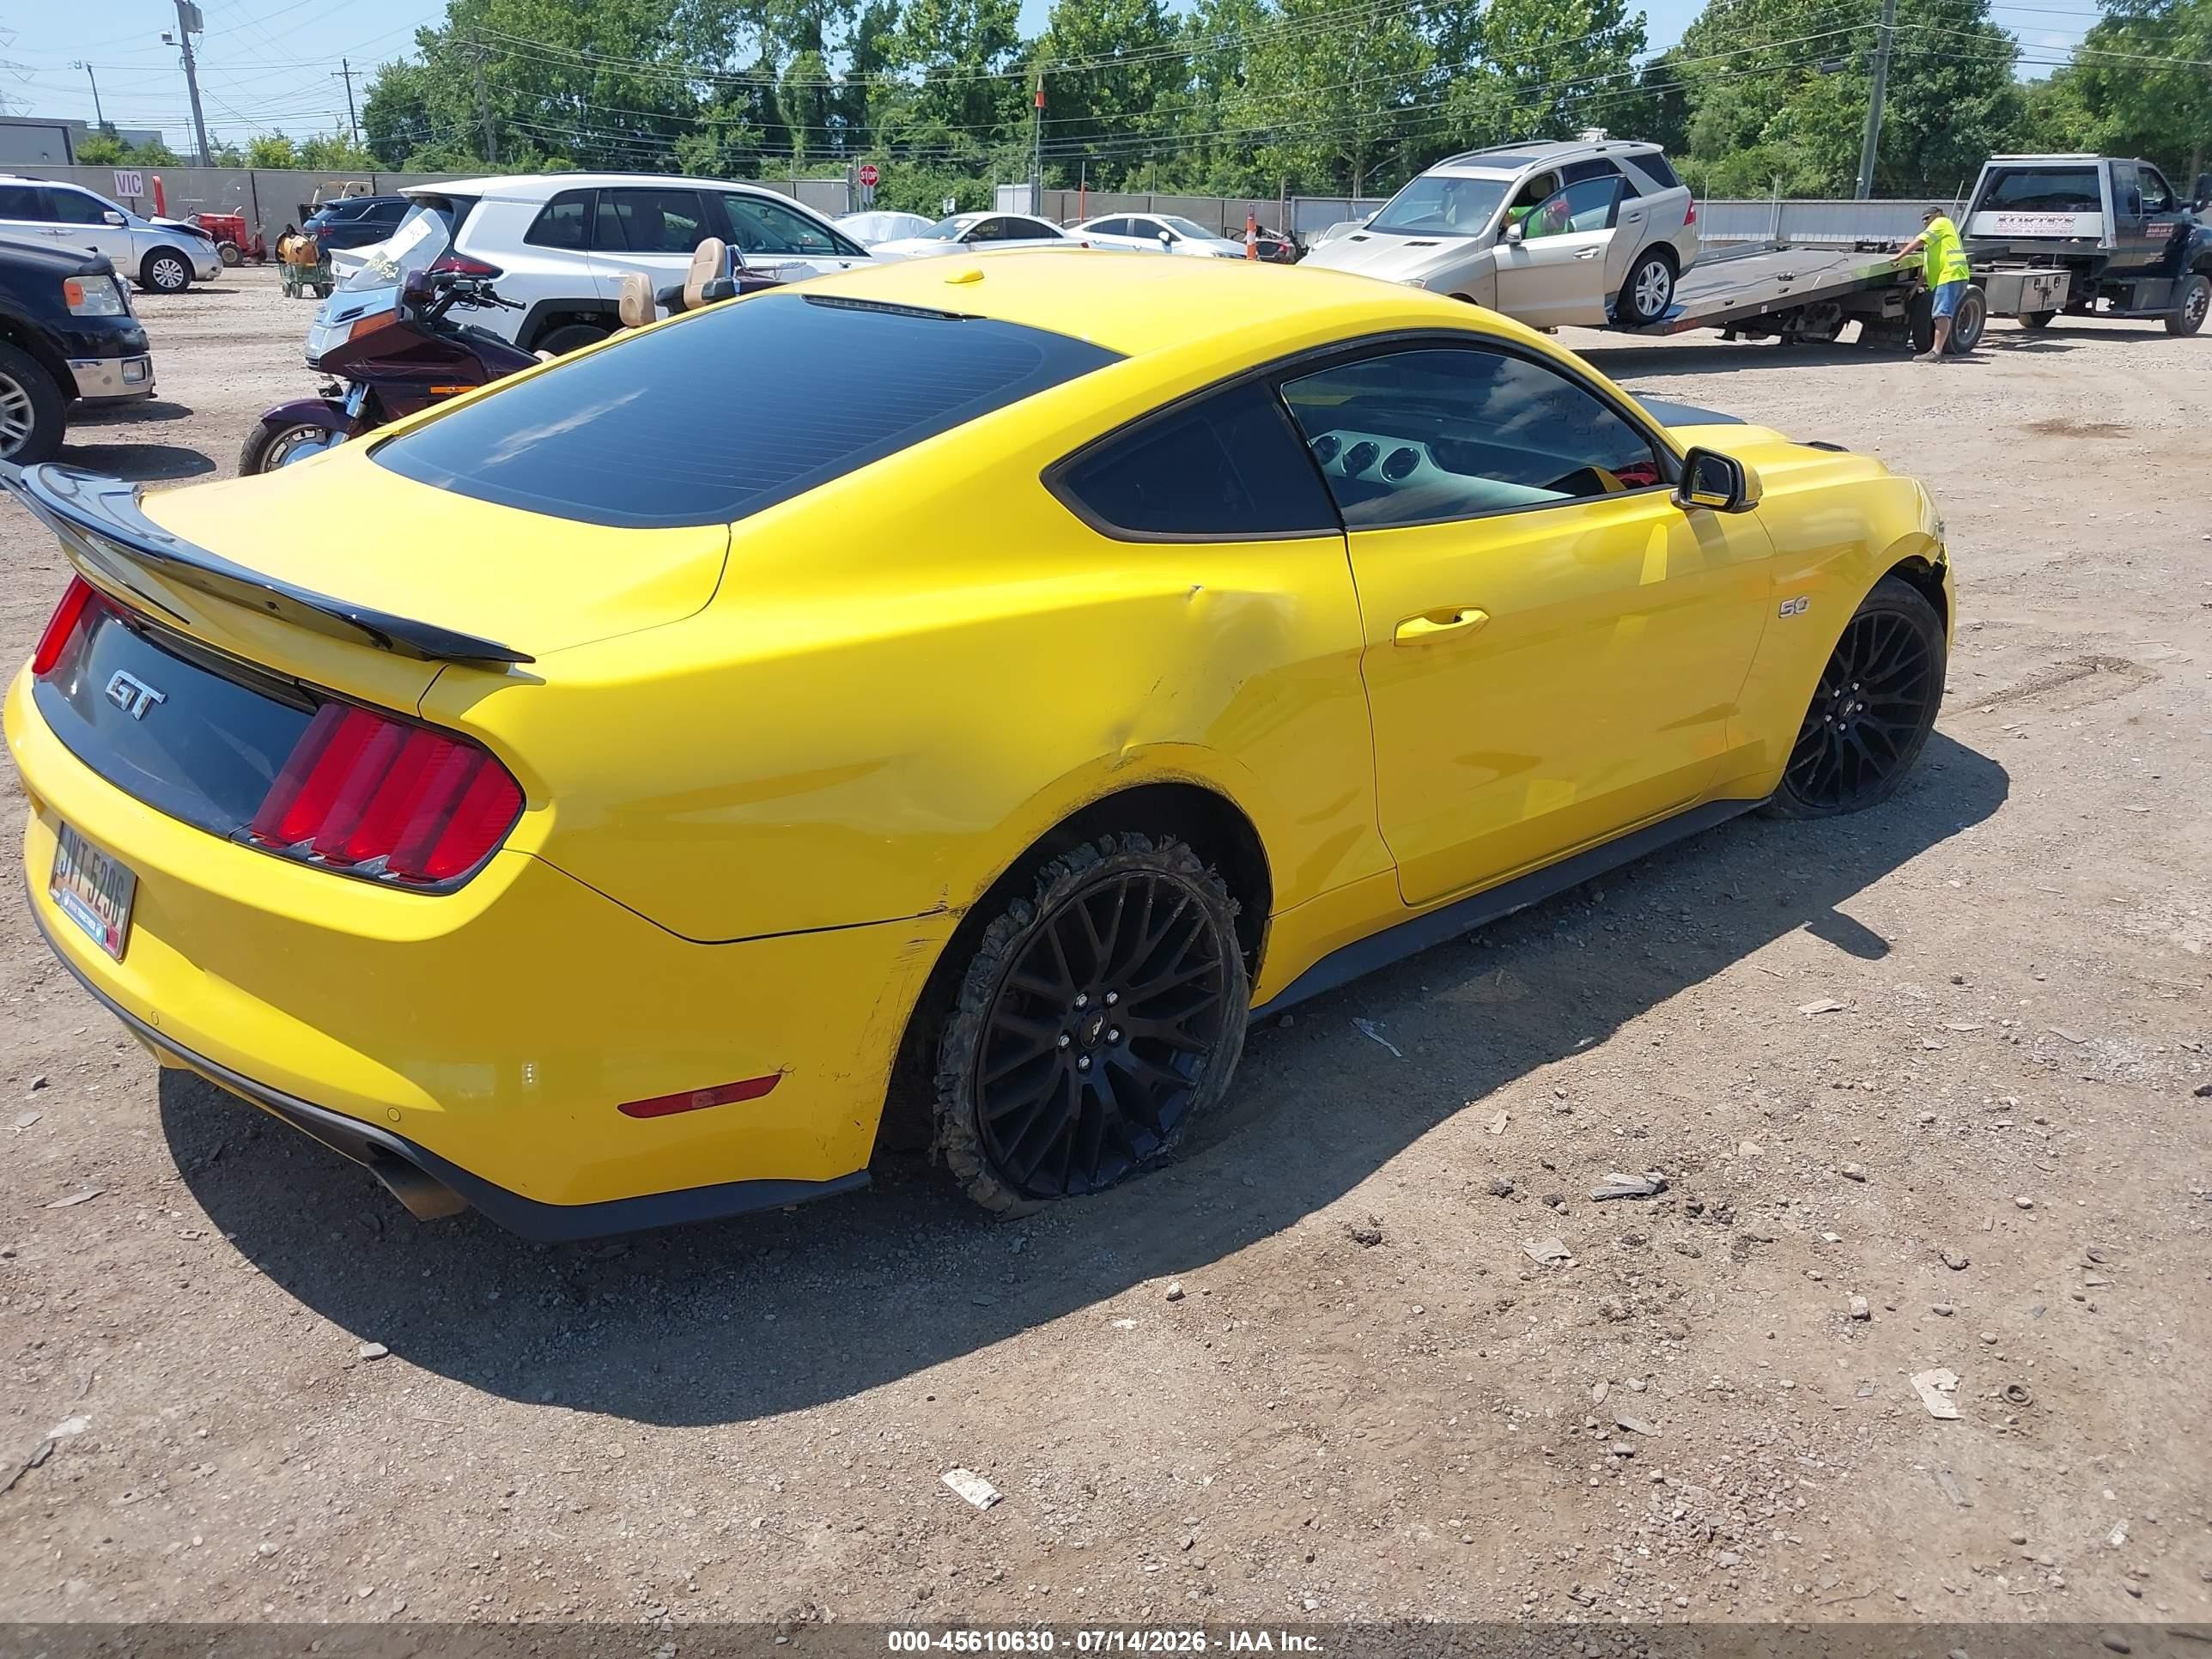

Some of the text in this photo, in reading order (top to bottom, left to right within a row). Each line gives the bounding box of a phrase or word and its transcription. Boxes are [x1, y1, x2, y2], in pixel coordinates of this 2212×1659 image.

[116, 174, 142, 194] VIC
[860, 171, 877, 180] STOP
[105, 669, 167, 721] GT
[60, 830, 125, 927] JVT 5296
